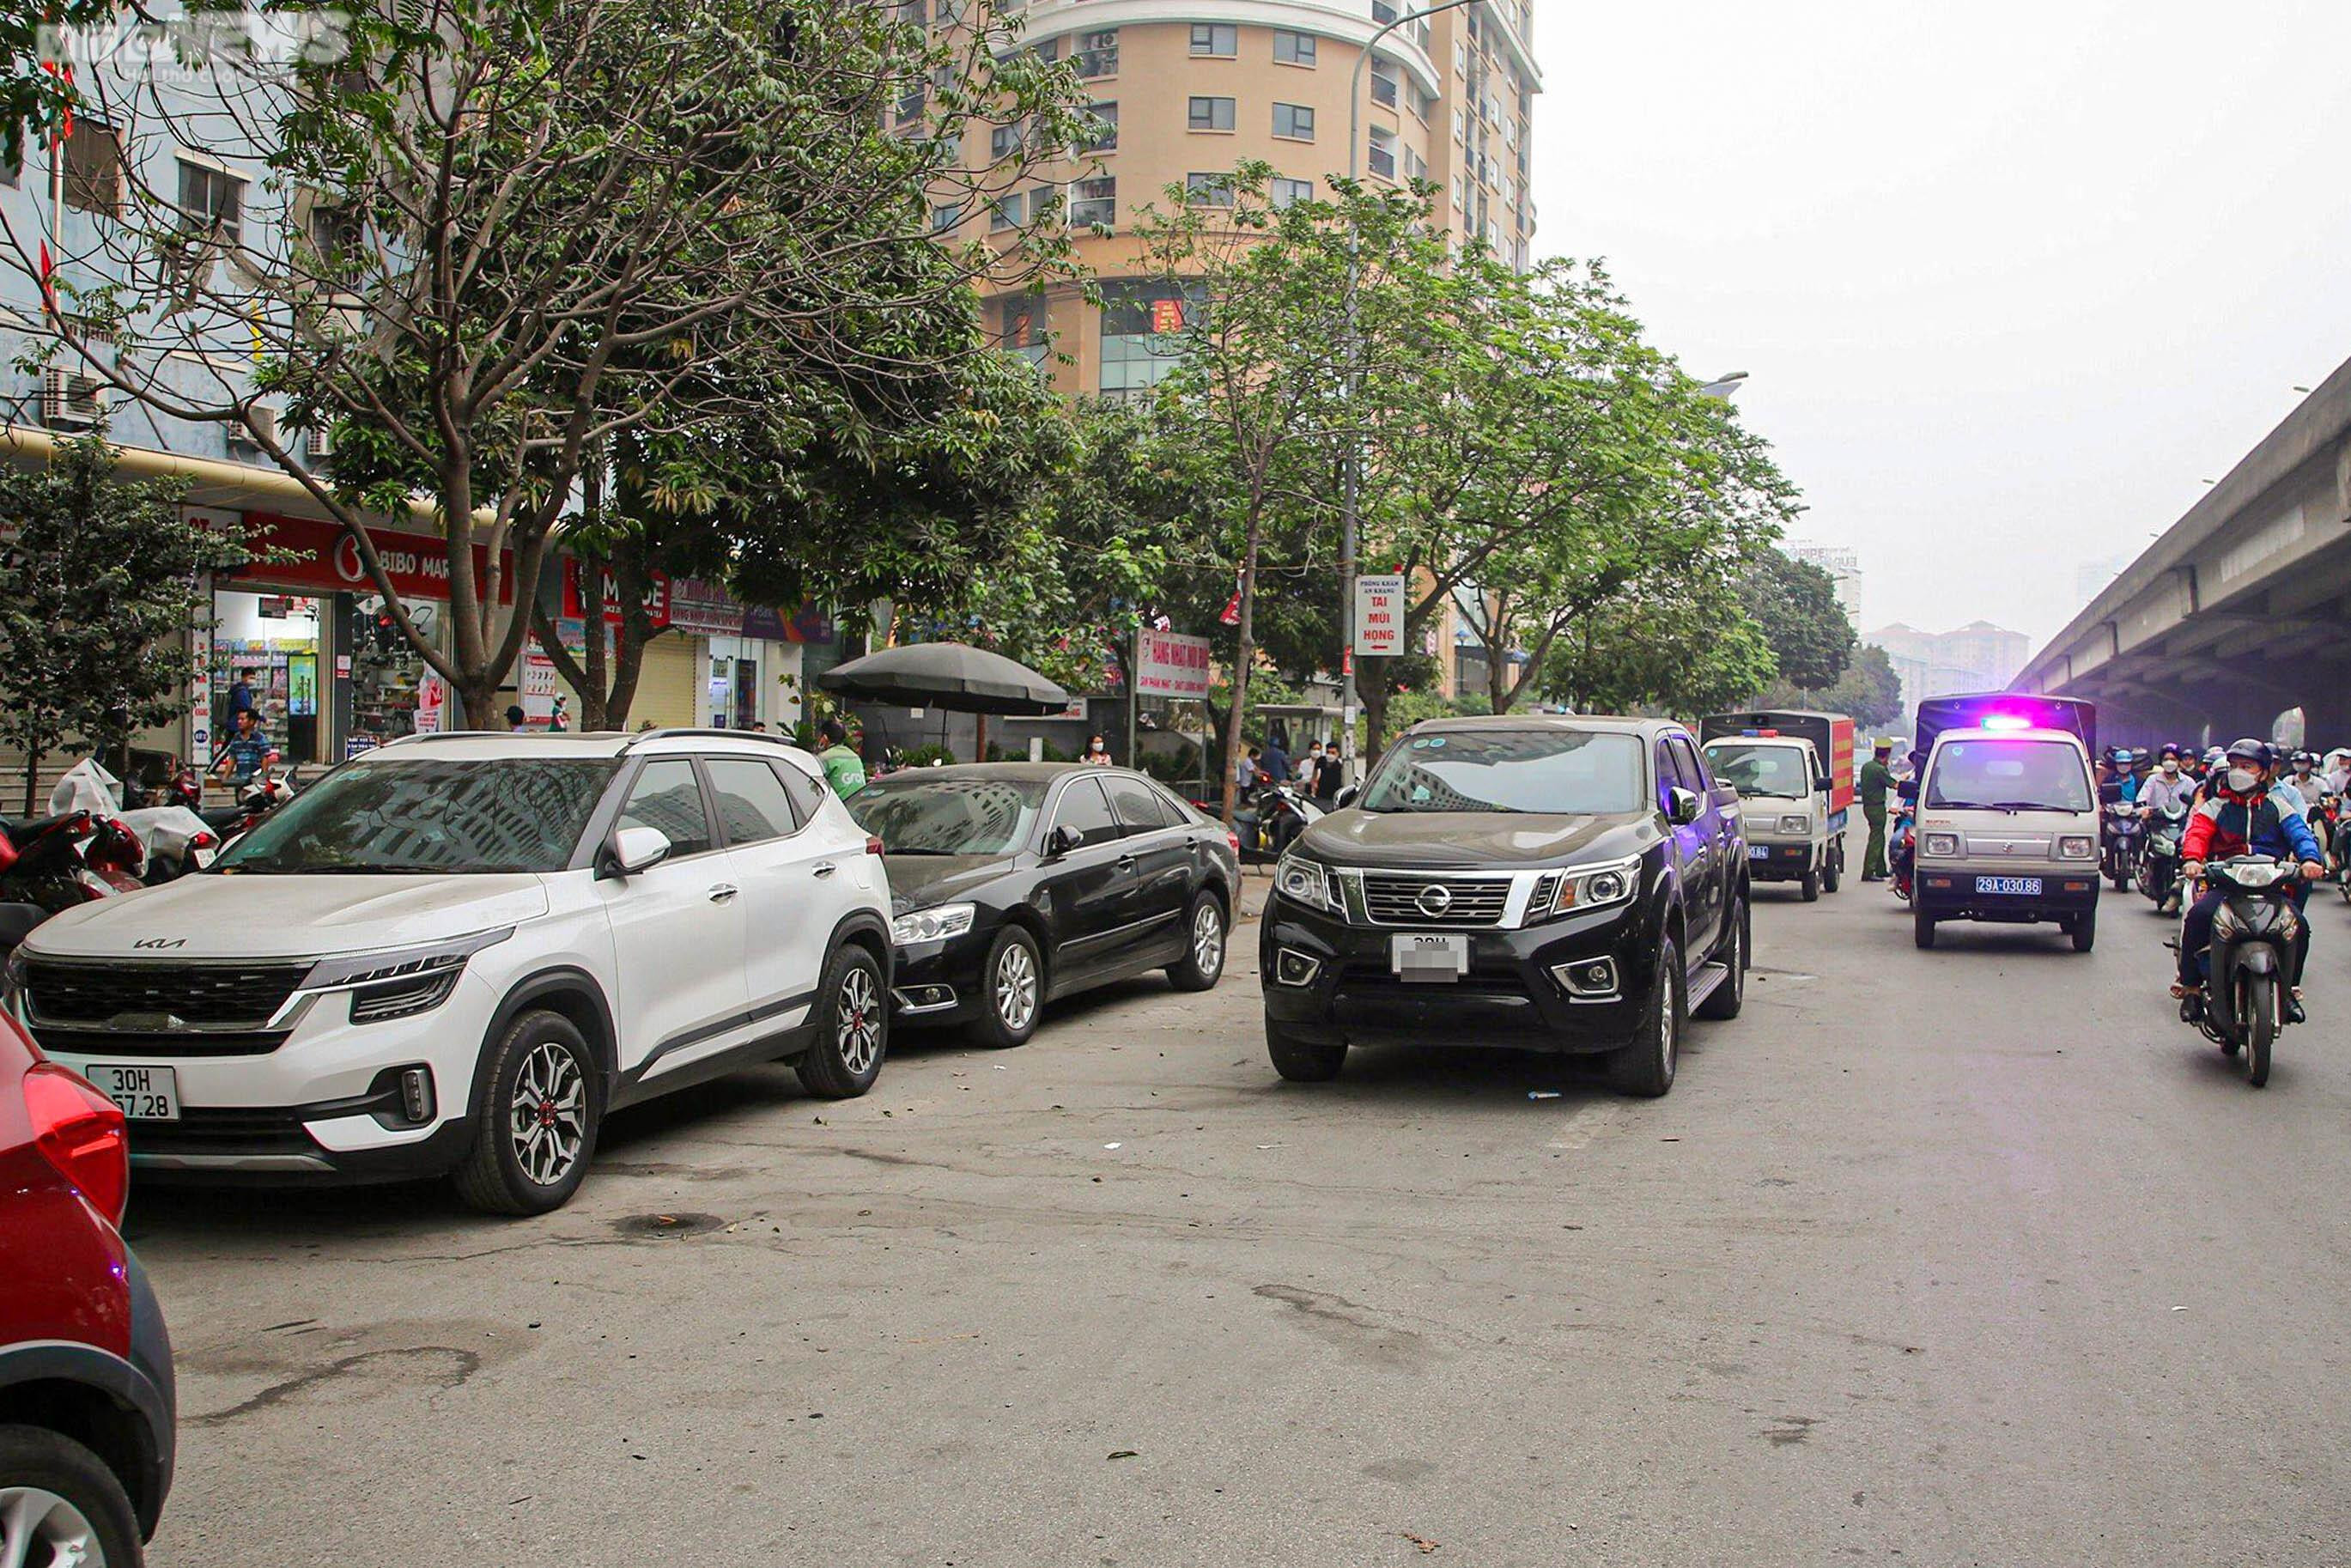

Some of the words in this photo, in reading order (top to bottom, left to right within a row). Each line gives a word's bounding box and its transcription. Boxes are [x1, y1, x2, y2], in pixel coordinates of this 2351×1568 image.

[379, 550, 416, 574] BIBO
[422, 557, 450, 579] MAR
[1372, 596, 1388, 606] TAI
[1364, 629, 1394, 641] HỌNG
[841, 772, 866, 785] Gra
[133, 939, 187, 949] KIA
[112, 1069, 150, 1091] 30H
[112, 1094, 169, 1117] 57.28
